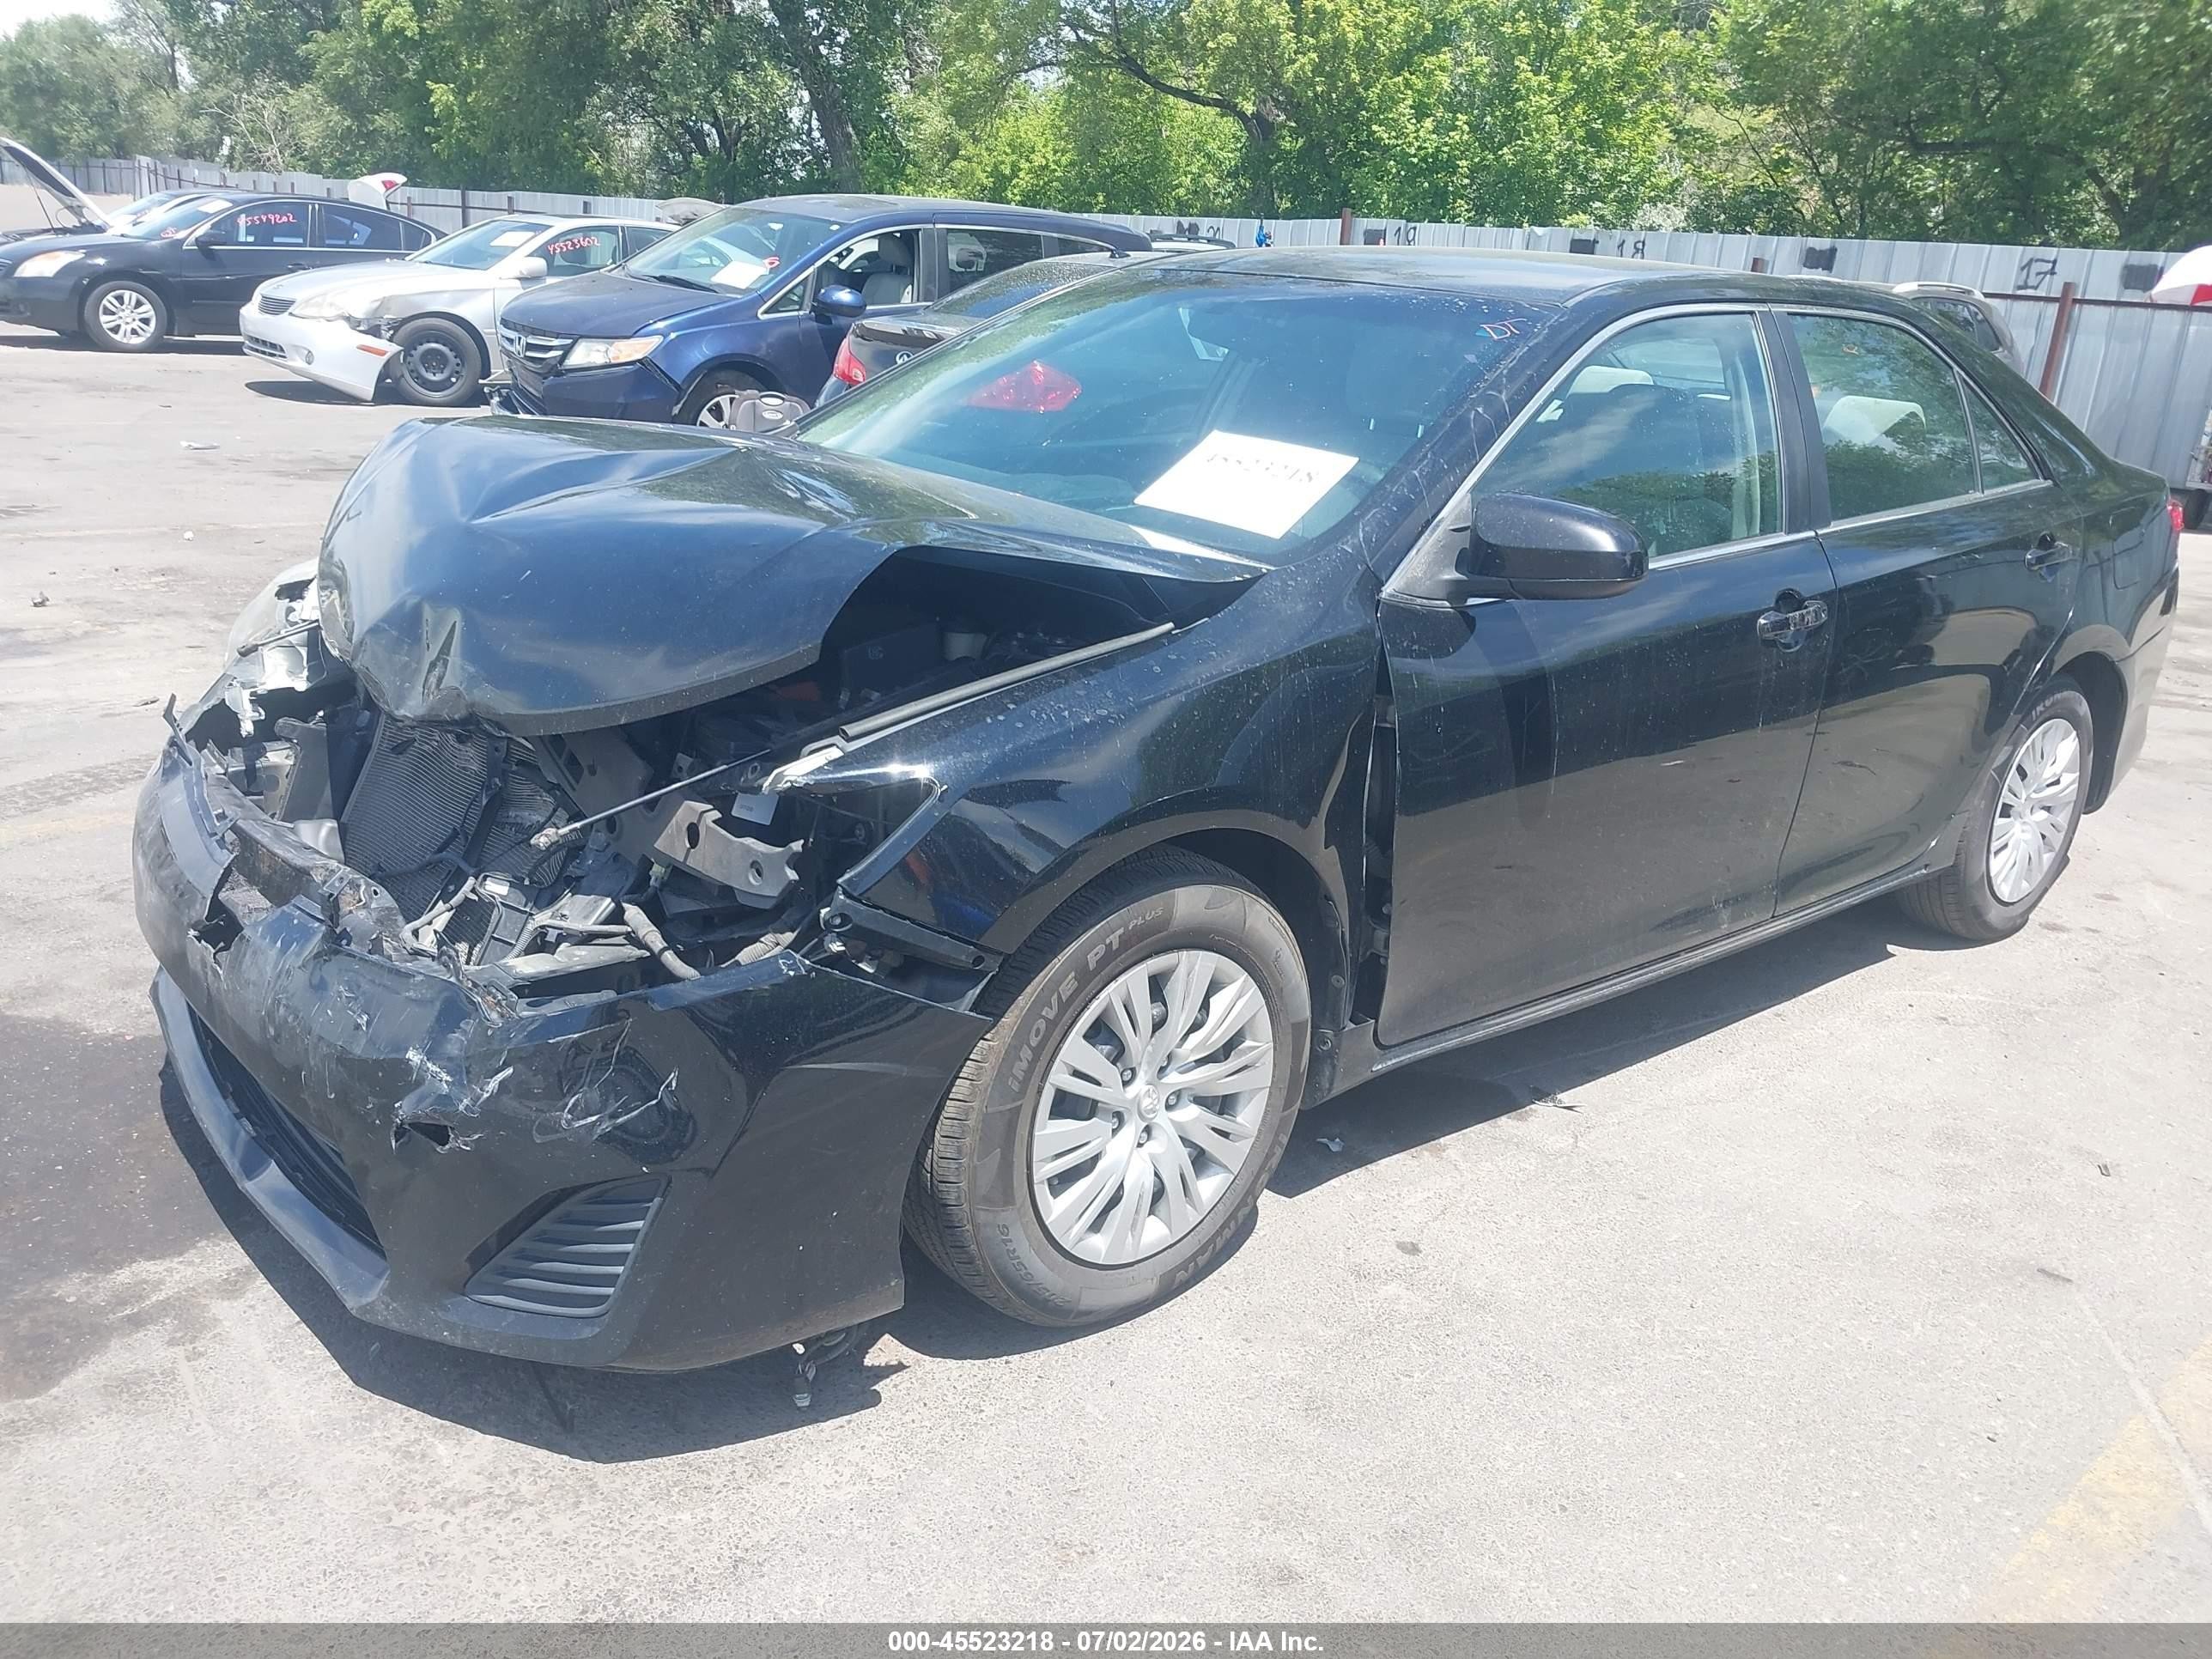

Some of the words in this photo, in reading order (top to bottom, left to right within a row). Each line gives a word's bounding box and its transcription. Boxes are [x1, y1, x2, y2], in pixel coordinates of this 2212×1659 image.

[548, 236, 601, 255] 45523602
[2015, 258, 2058, 290] 17
[1087, 927, 1125, 971] PT
[1128, 907, 1164, 931] PLUS
